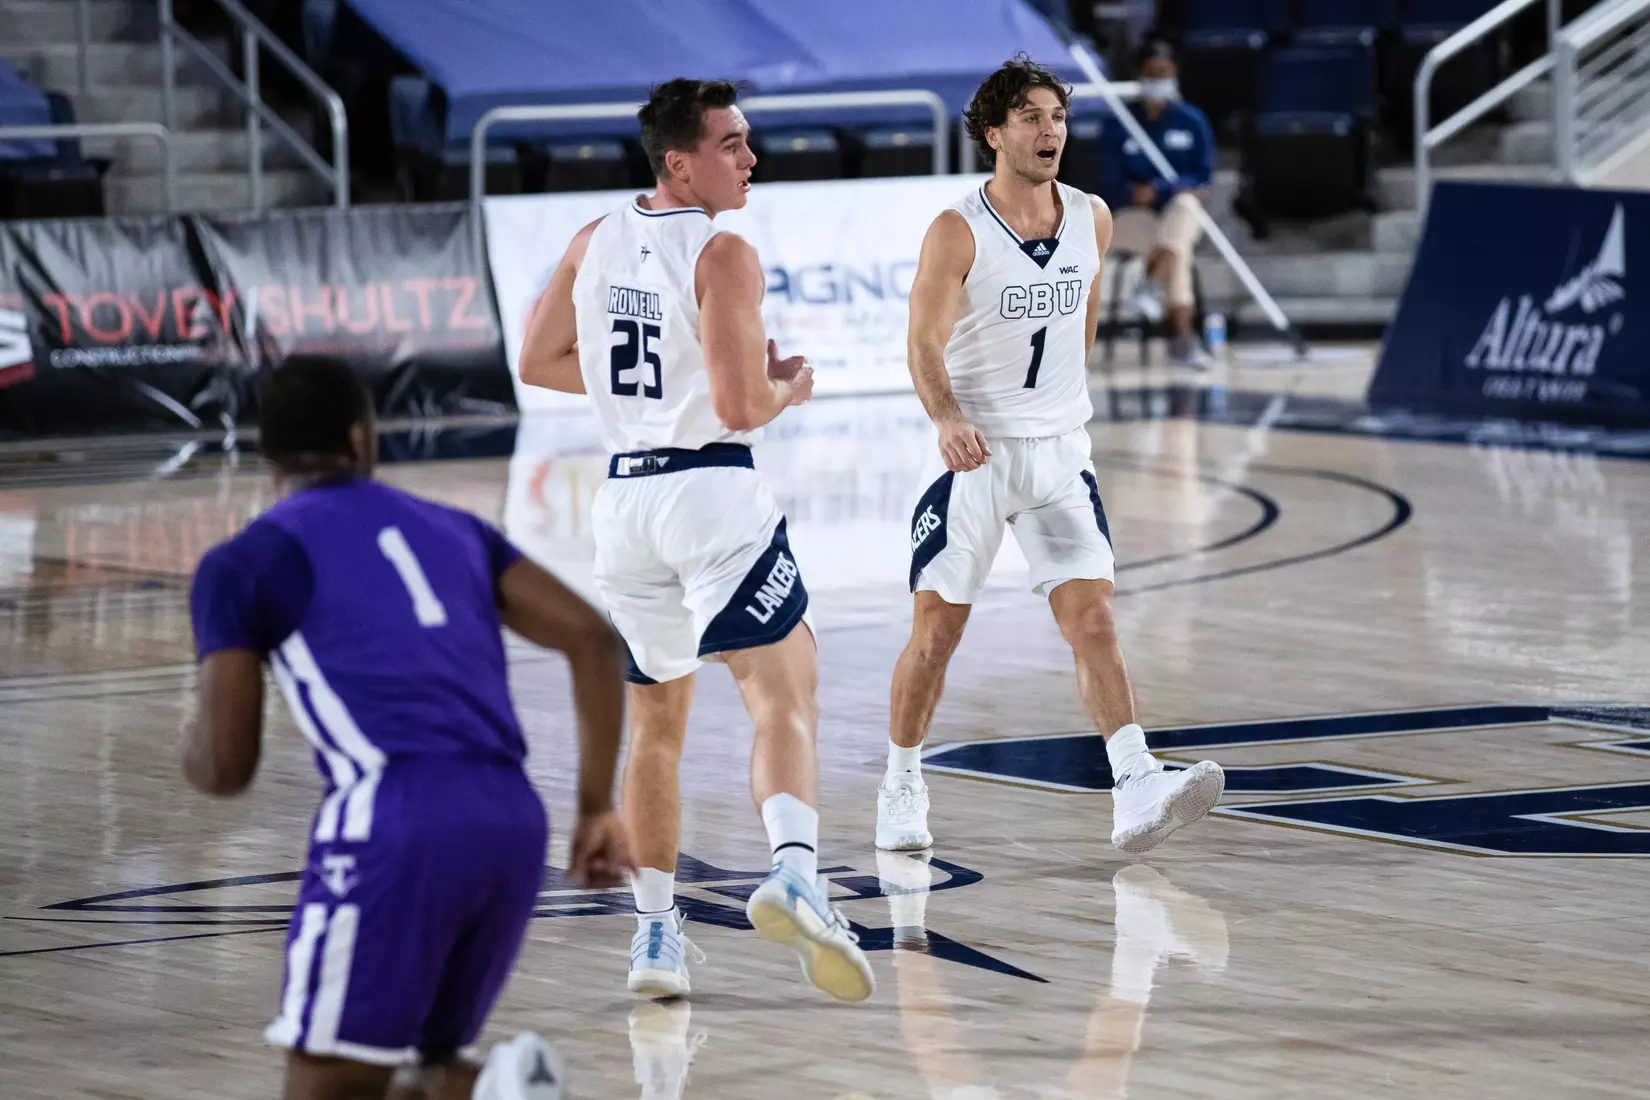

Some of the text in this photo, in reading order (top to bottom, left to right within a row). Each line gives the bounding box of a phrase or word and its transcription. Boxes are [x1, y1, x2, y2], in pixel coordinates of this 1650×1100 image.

[607, 285, 663, 321] ROWELL
[1000, 279, 1082, 320] CBU
[1058, 265, 1079, 275] WAC
[610, 318, 663, 400] 25
[1022, 326, 1048, 389] 1
[1463, 293, 1606, 376] Altura
[376, 525, 448, 628] 1
[744, 550, 798, 625] LANCERS
